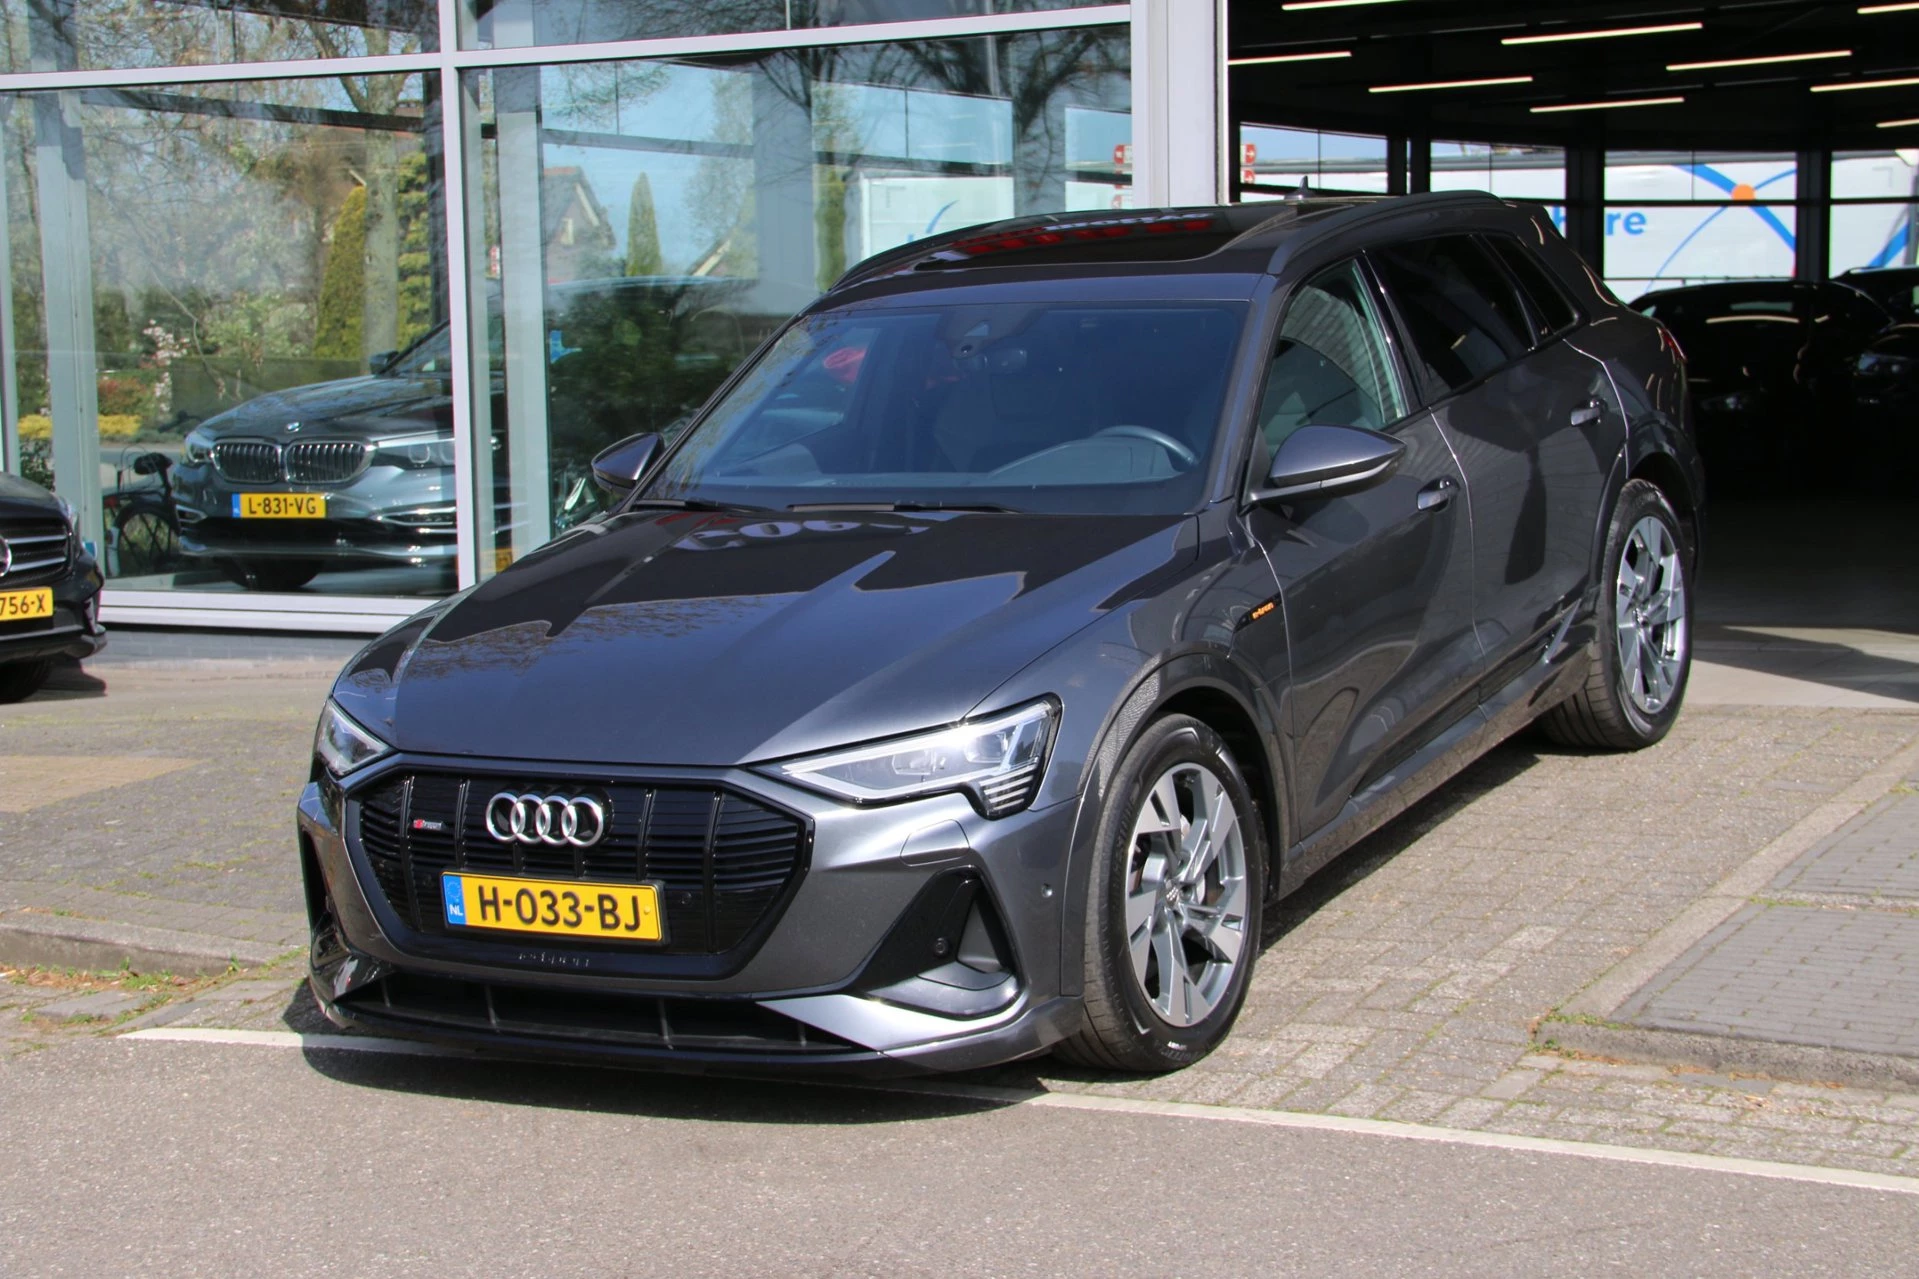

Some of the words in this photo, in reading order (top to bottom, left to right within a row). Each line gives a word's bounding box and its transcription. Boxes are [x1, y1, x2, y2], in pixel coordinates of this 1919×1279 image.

[248, 497, 317, 515] L-831-VG
[449, 903, 465, 917] NL
[477, 884, 641, 932] H-033-BJ
